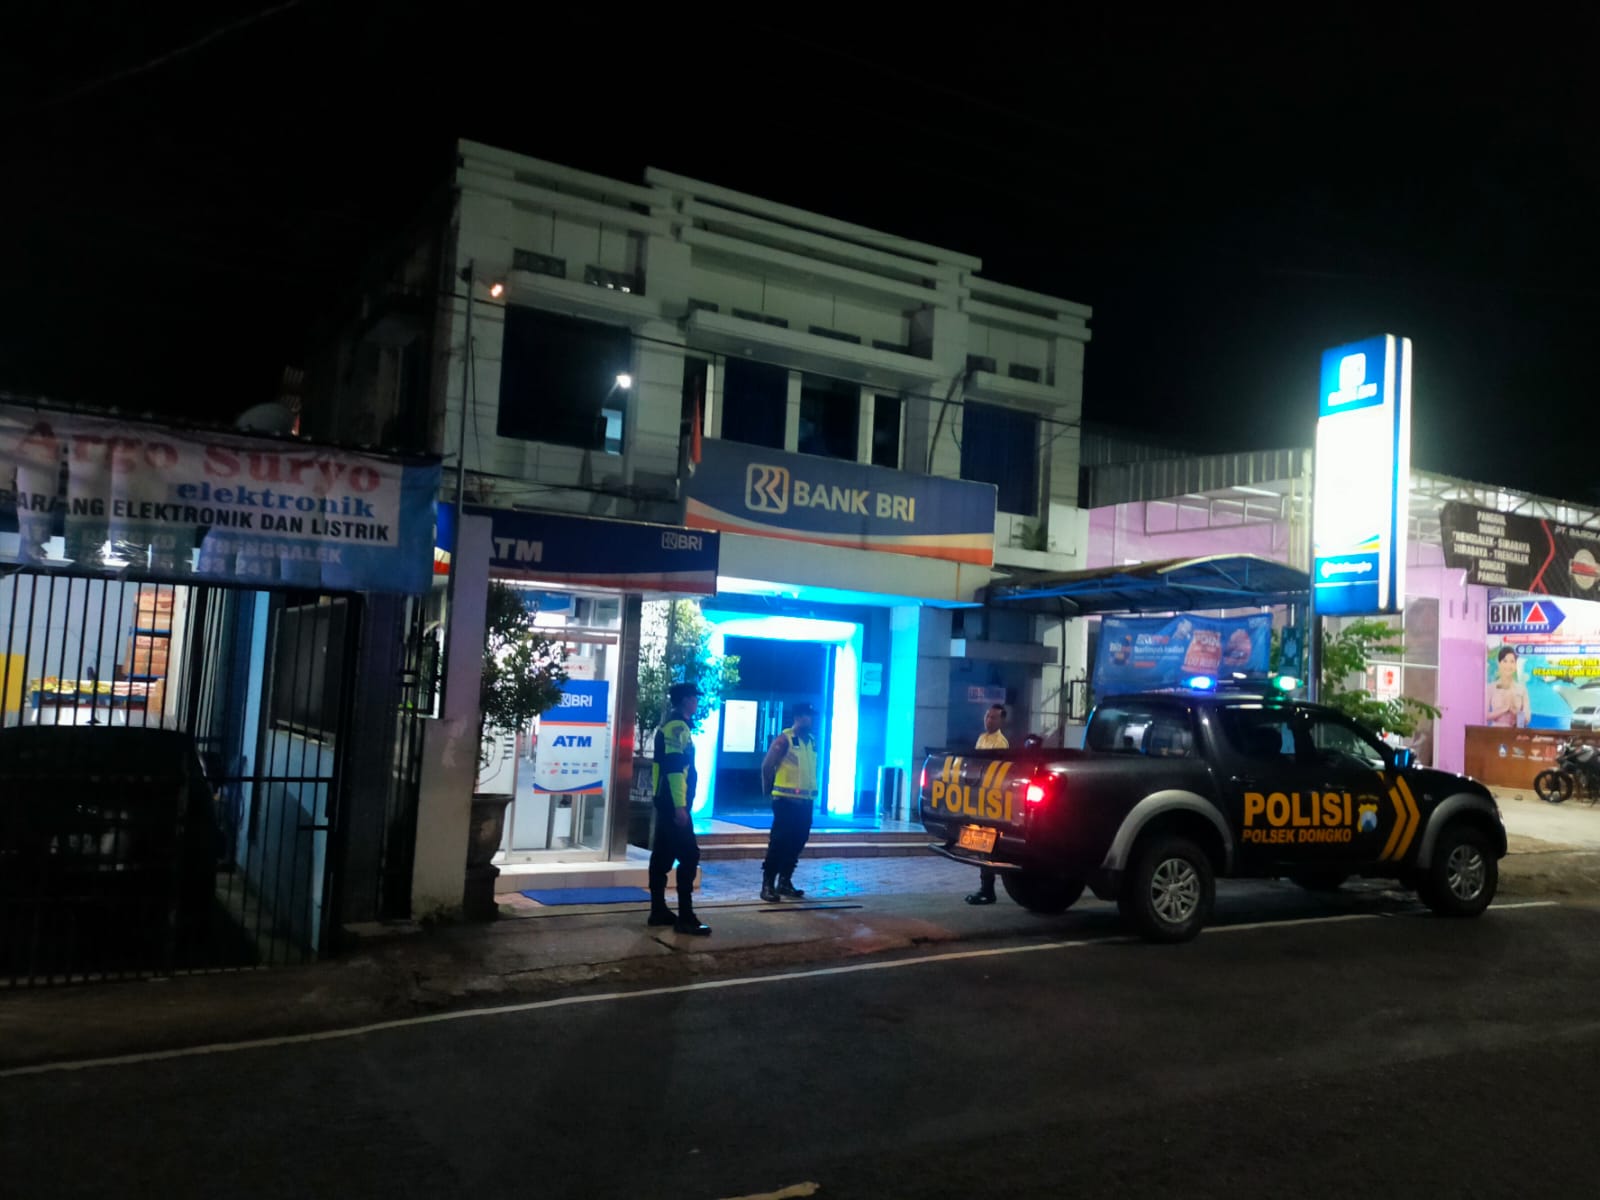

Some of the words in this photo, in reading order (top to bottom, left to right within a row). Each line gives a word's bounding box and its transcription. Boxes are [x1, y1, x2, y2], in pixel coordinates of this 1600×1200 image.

[203, 445, 380, 495] Suryo
[177, 481, 375, 518] elektronik
[793, 480, 870, 516] BANK
[876, 492, 915, 522] BRI
[114, 500, 252, 529] ELEKTRONIK
[260, 513, 303, 533] DAN
[312, 520, 389, 541] LISTRIK
[678, 534, 702, 551] BRI
[1490, 603, 1522, 623] BIM
[571, 694, 593, 707] BRI
[552, 735, 593, 748] ATM
[931, 780, 1014, 822] POLISI
[1244, 791, 1352, 827] POLISI
[1243, 828, 1295, 844] POLSEK
[1298, 828, 1351, 843] DONGKO
